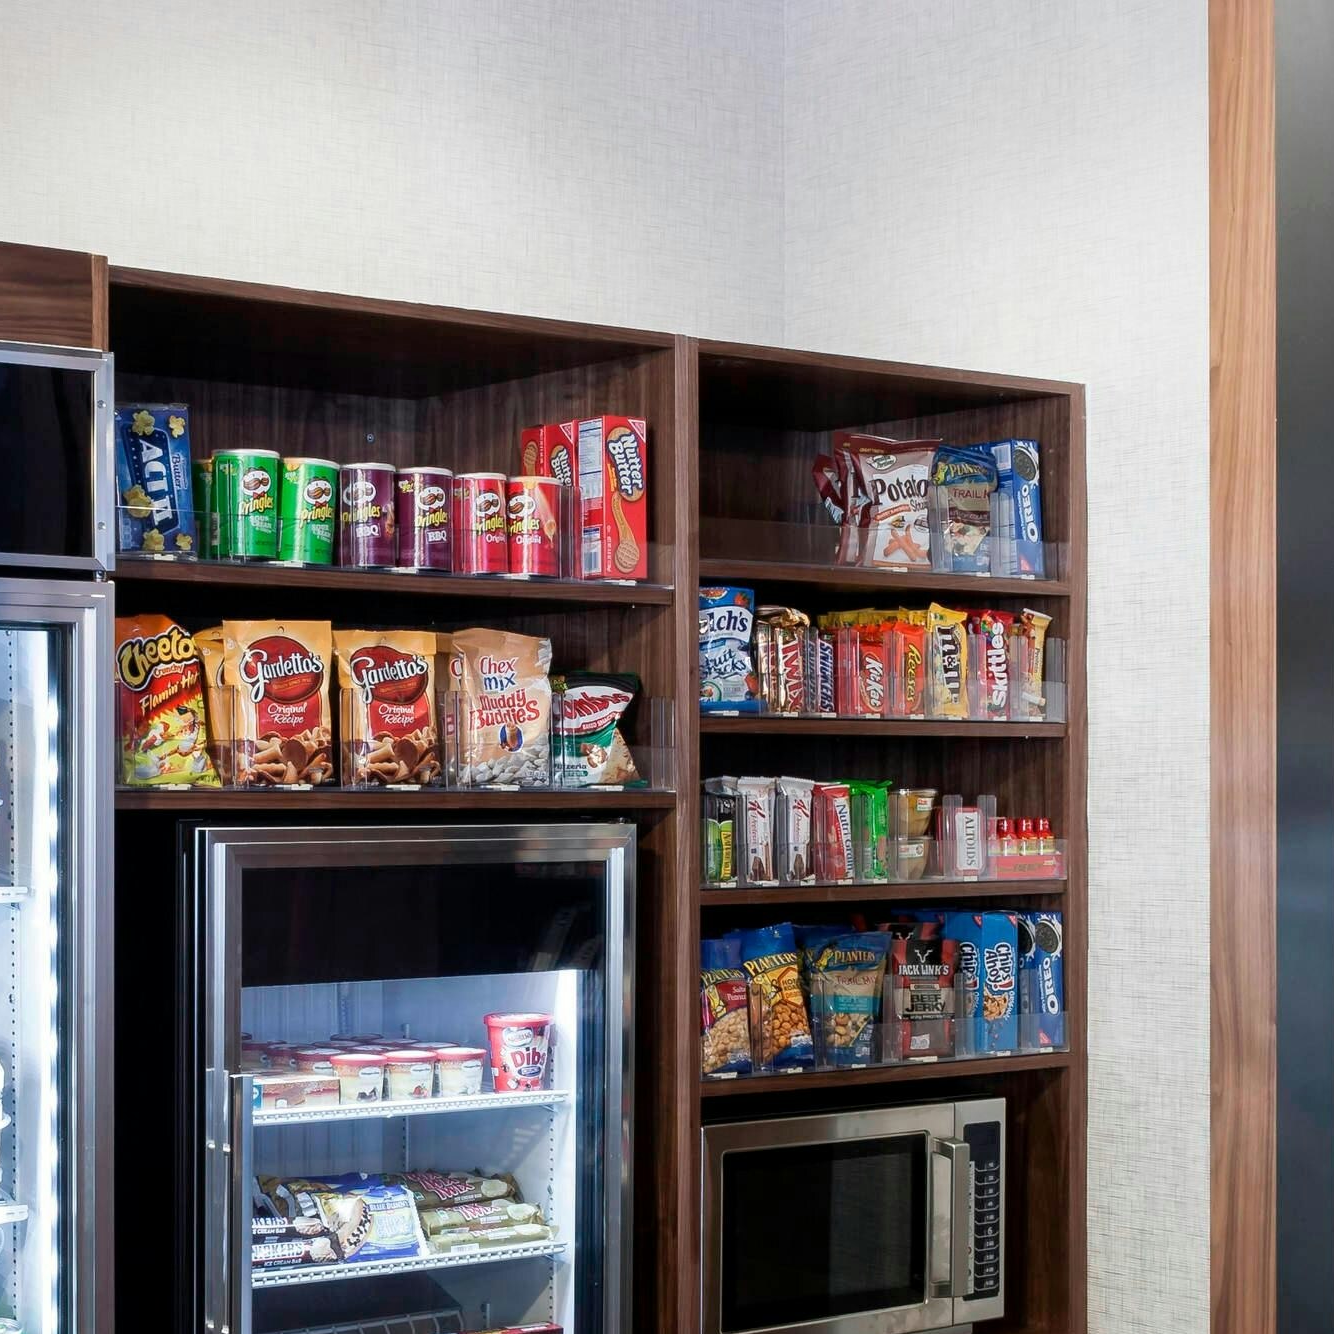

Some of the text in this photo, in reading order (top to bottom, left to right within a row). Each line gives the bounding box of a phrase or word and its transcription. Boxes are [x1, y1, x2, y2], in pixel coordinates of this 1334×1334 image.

[558, 449, 572, 487] Nutte
[608, 441, 633, 495] Butter
[622, 434, 643, 489] Nutter
[869, 474, 928, 506] Potato
[699, 609, 749, 633] lch's
[116, 625, 198, 690] Cheeto
[480, 655, 517, 676] Chex
[240, 649, 324, 703] Gardetto's
[351, 655, 429, 704] Gardetto's
[268, 703, 307, 717] Original
[378, 704, 415, 718] Original
[479, 687, 527, 711] Muddy
[273, 713, 305, 727] Recipe
[383, 713, 415, 725] Recipe
[469, 699, 540, 730] Buddies
[743, 951, 797, 978] PLANTERS
[834, 950, 876, 964] PLANTERS
[898, 964, 920, 976] JACK
[1042, 957, 1059, 1015] OREO
